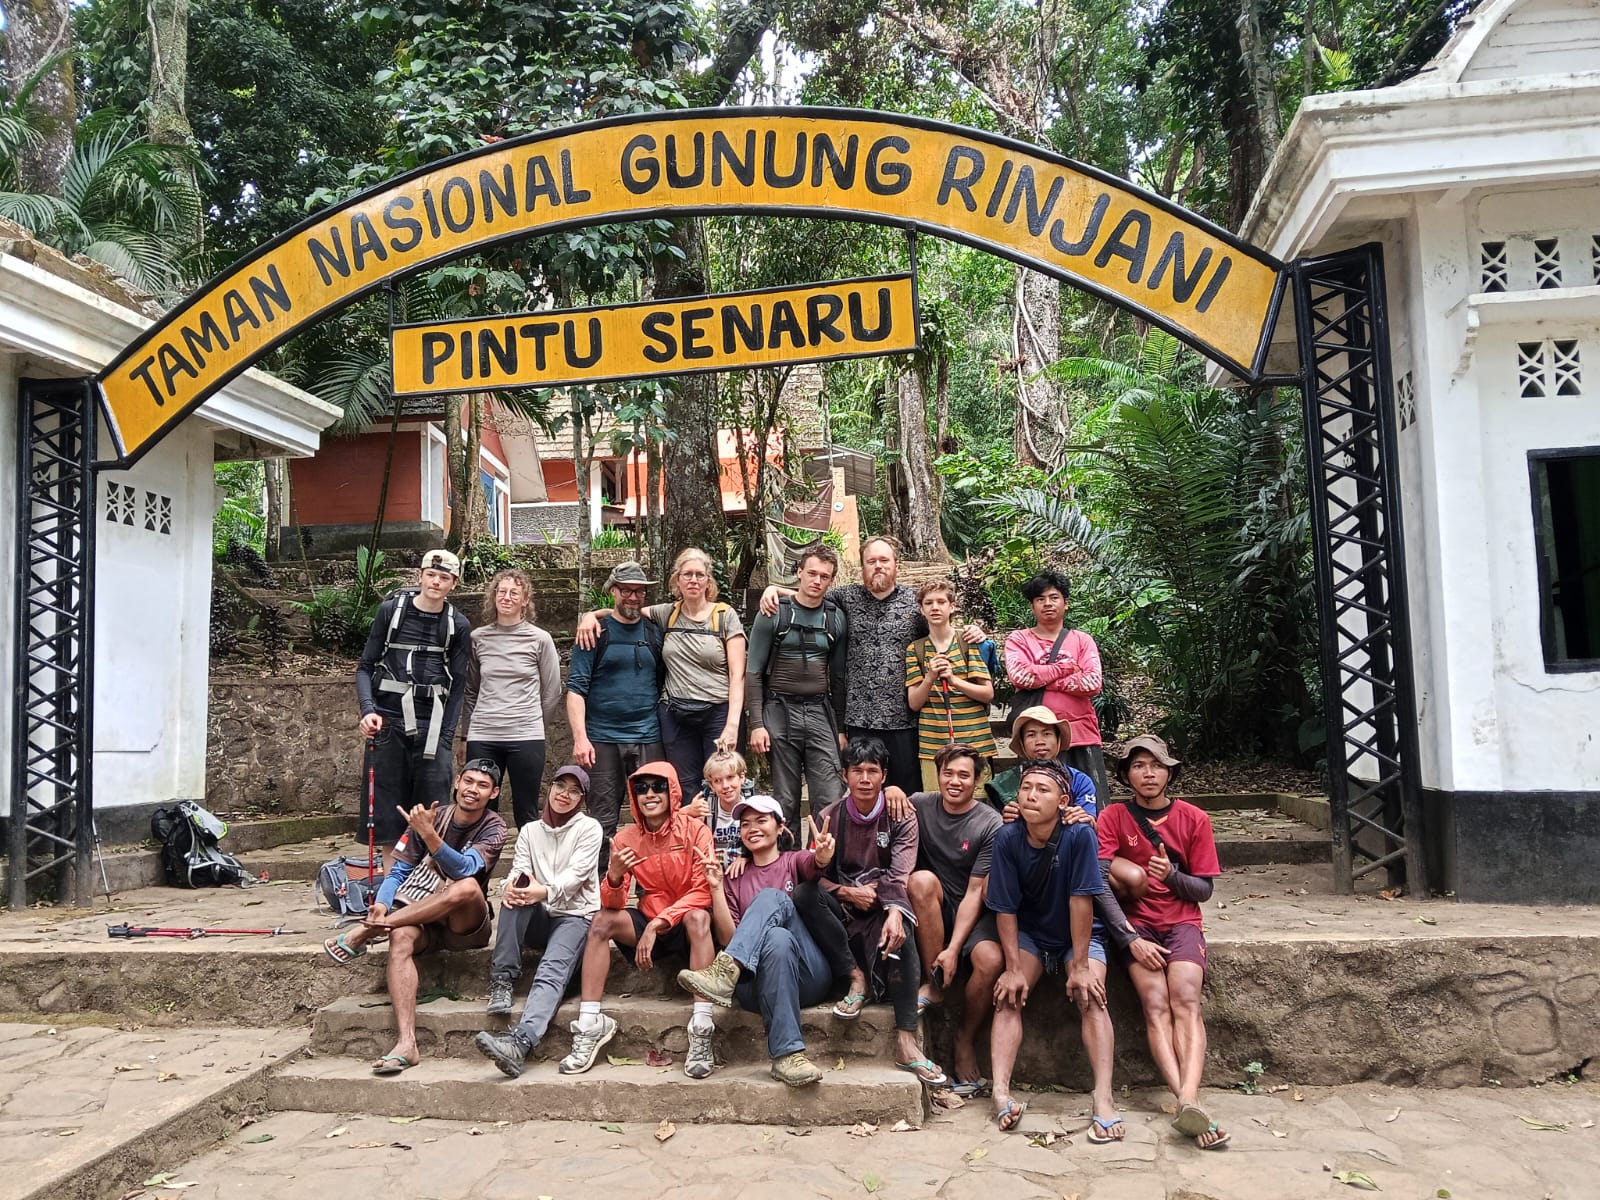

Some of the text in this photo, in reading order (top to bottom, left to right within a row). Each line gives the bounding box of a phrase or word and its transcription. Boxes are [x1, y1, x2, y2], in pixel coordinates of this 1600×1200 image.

[130, 129, 1233, 407] TAMAN NASIONAL GUNUNG RINJANI
[421, 287, 893, 384] PINTU SENARU
